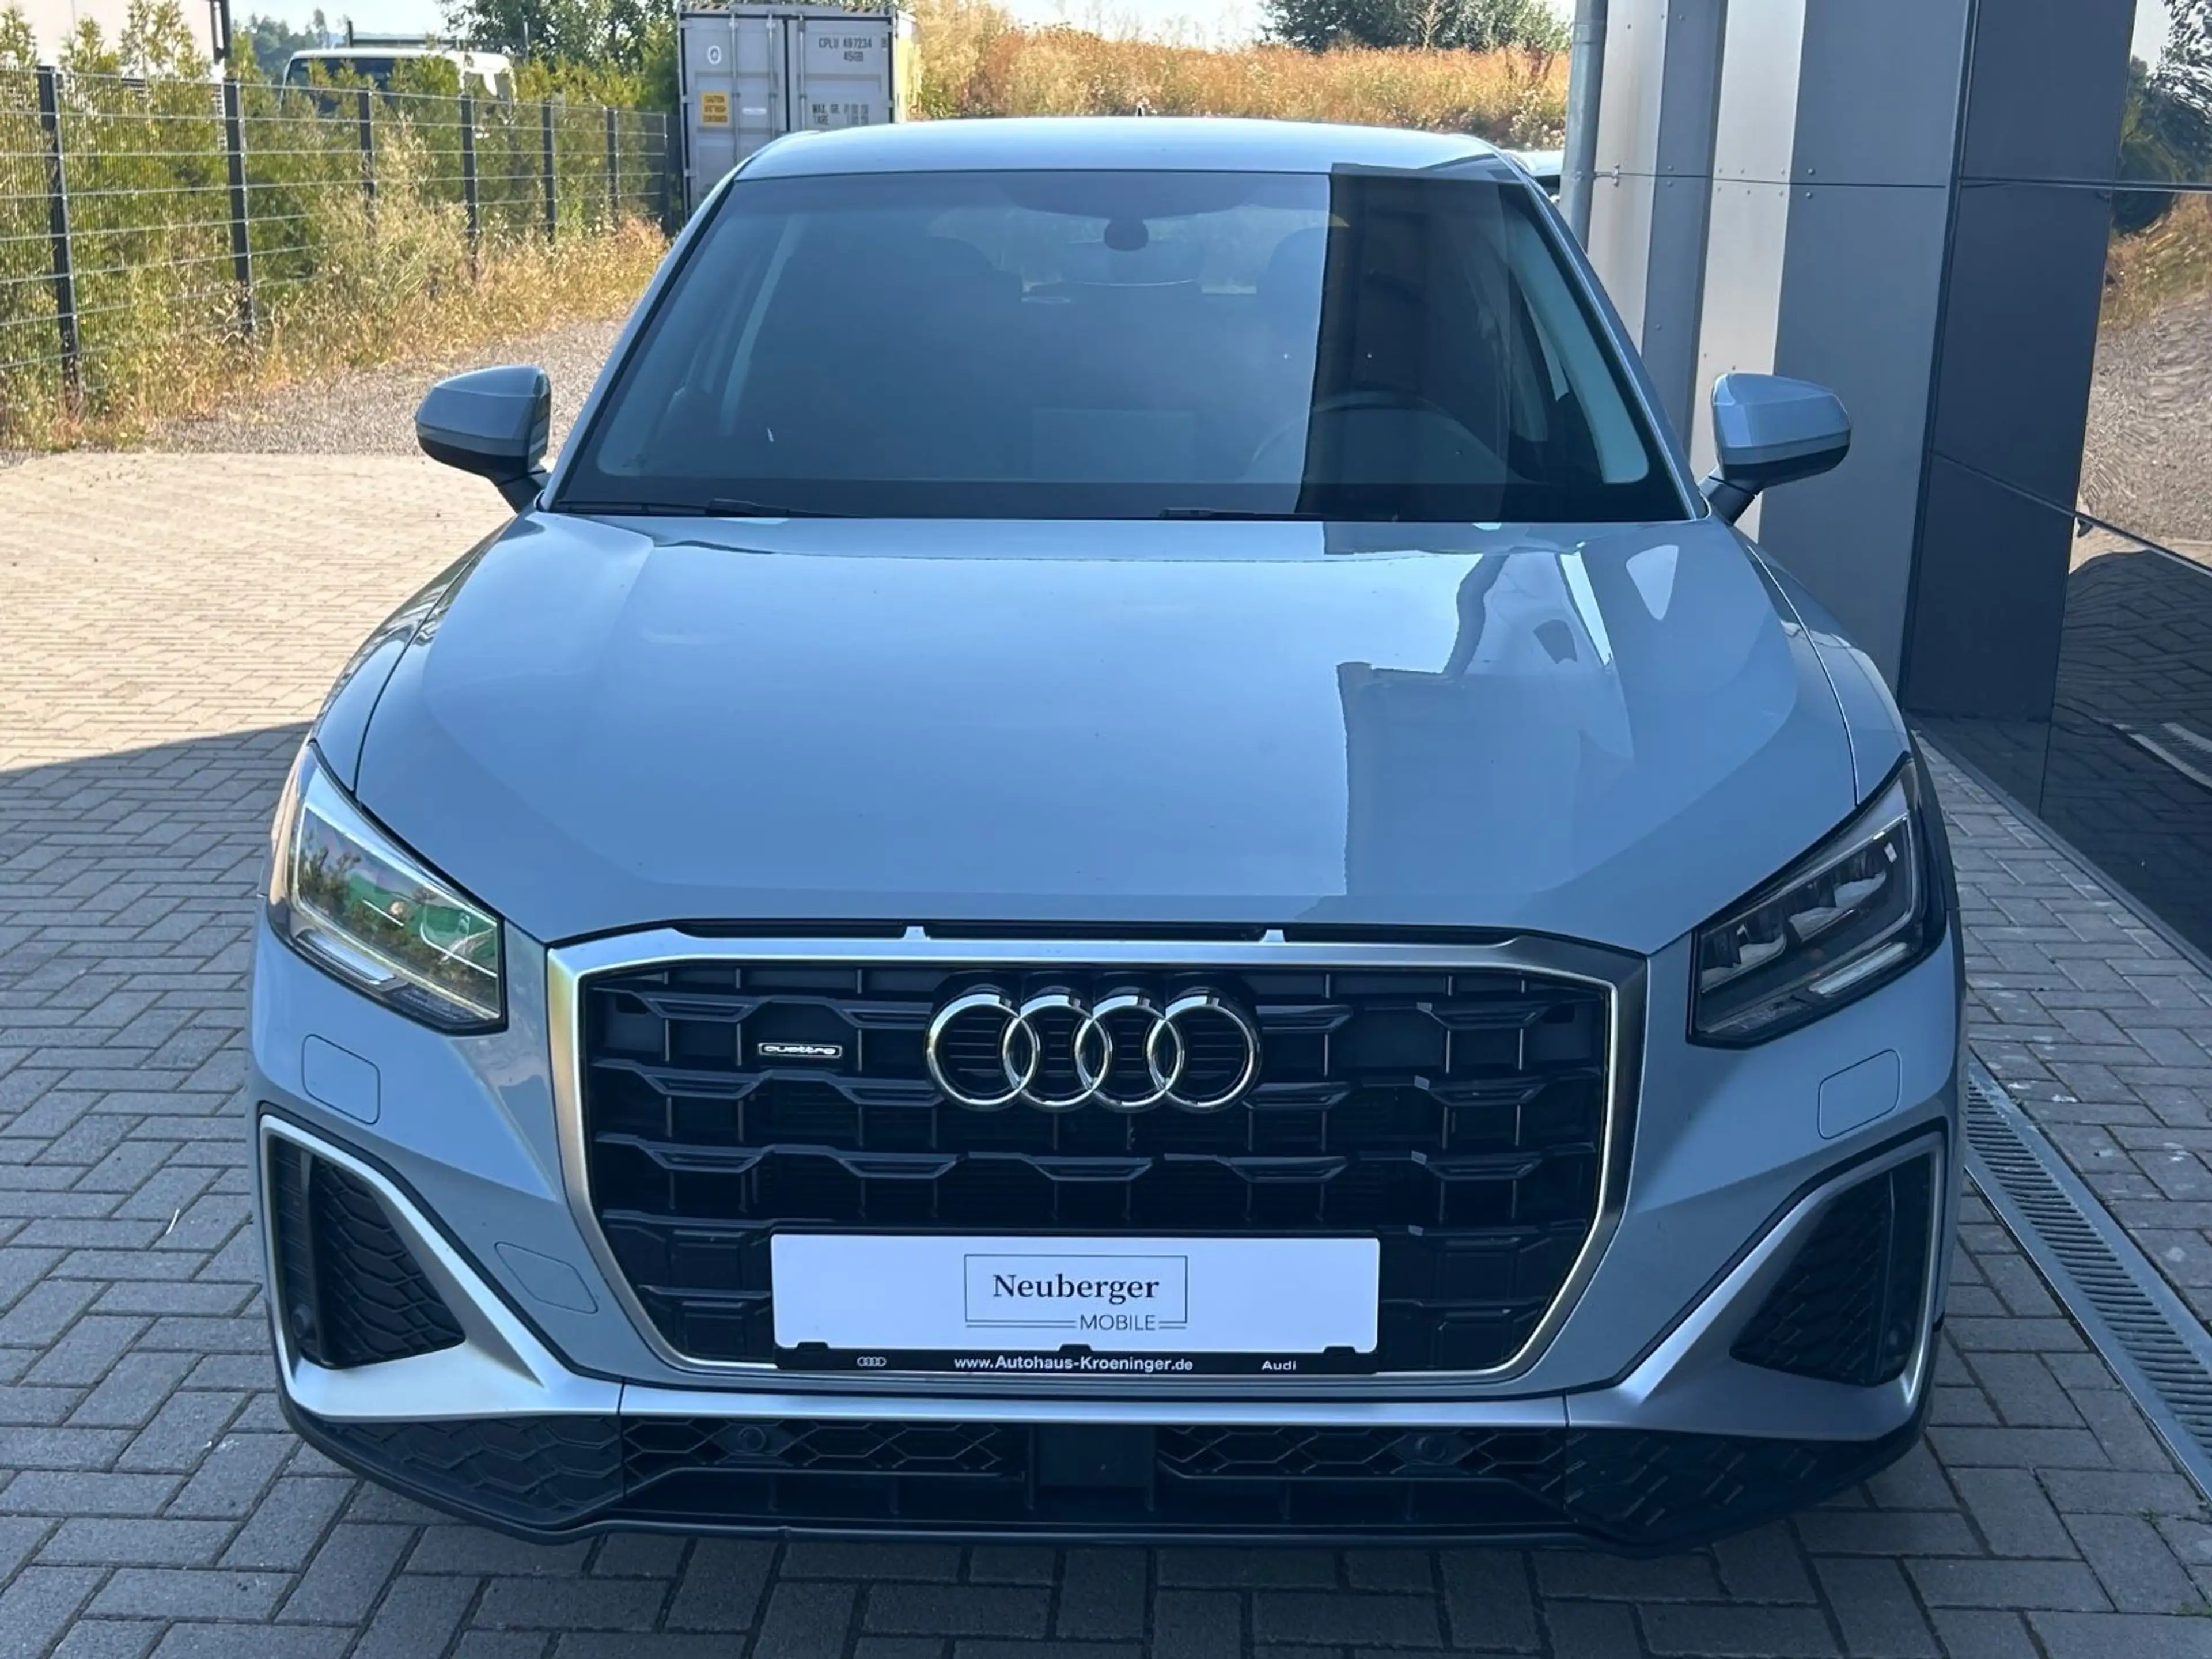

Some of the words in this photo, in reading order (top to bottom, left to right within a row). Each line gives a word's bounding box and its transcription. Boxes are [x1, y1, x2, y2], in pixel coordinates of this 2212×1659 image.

[763, 1044, 837, 1055] quattro
[993, 1273, 1160, 1305] Neuberger
[1080, 1314, 1157, 1331] MOBILE
[953, 1355, 1194, 1372] www.Autohaus-Kroeninger.de
[1261, 1360, 1297, 1371] Audi
